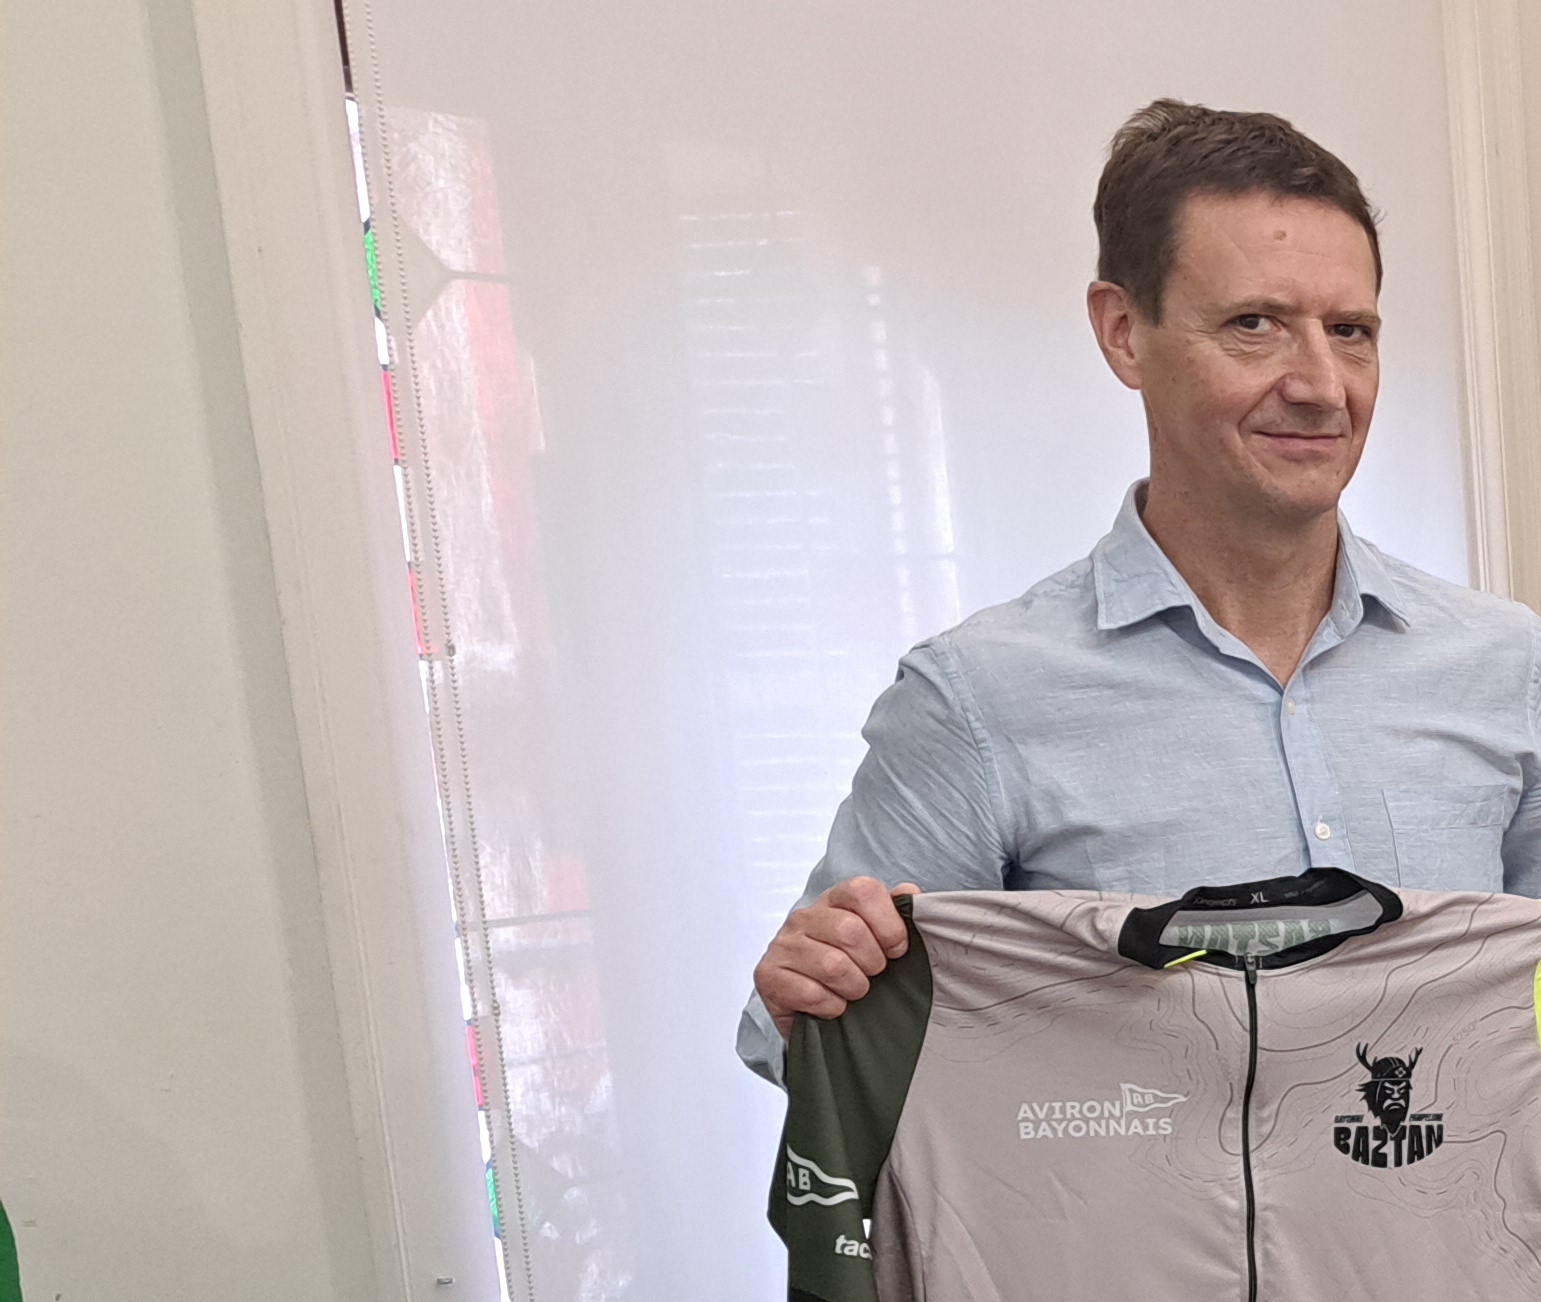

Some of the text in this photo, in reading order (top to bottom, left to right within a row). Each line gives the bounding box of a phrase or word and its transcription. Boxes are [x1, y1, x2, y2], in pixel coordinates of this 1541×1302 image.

[1250, 890, 1269, 905] XL
[1132, 1092, 1155, 1105] AB
[1017, 1100, 1121, 1121] AVIRON
[1018, 1118, 1173, 1139] BAYONNAIS
[1333, 1124, 1444, 1168] BAZTAN
